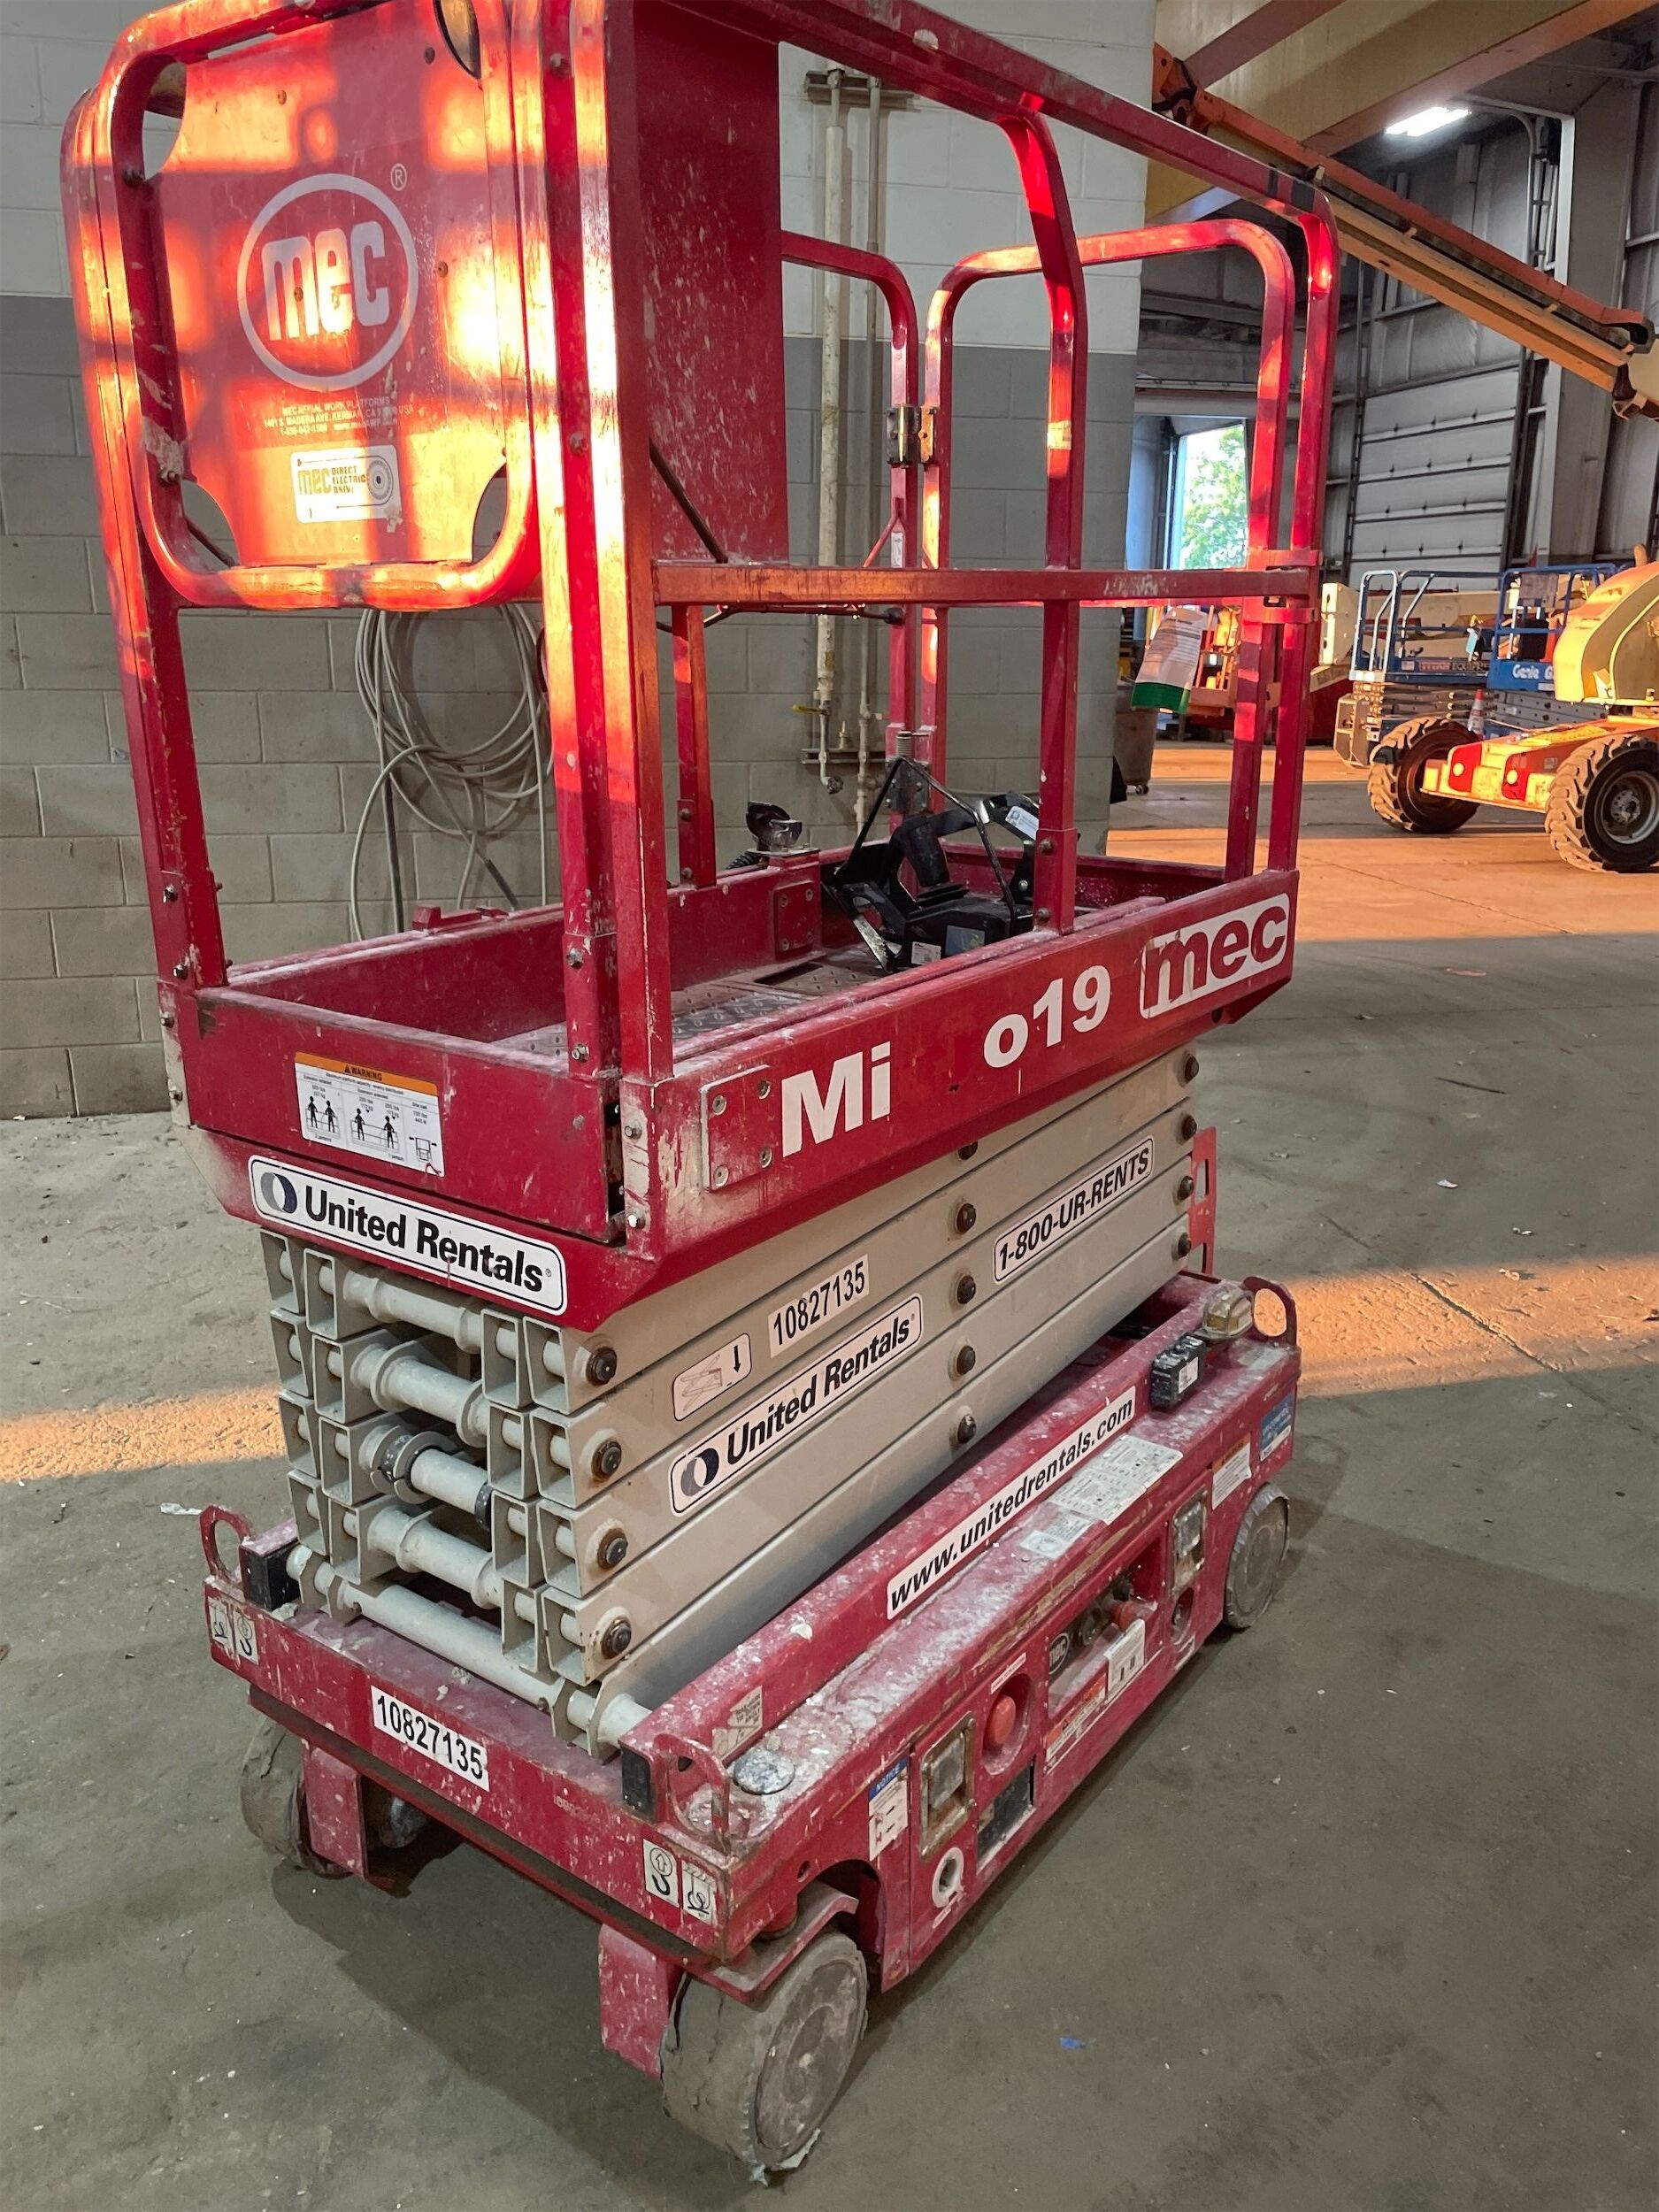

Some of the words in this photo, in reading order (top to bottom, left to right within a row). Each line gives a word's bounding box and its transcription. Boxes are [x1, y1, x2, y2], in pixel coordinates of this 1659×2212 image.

[332, 465, 357, 476] DIRECT
[333, 473, 367, 485] ELECTRIC
[1512, 664, 1540, 680] Genie
[351, 1066, 383, 1082] WARNING
[781, 1041, 891, 1157] Mi
[305, 1185, 407, 1248] United
[416, 1218, 543, 1293] Rentals
[999, 1146, 1151, 1271] 1-800-UR-RENTS
[773, 1260, 865, 1346] 10827135
[727, 1373, 818, 1465] United
[824, 1317, 910, 1398] Rentals
[891, 1399, 1133, 1611] www.unitedrentals.com
[377, 1695, 483, 1779] 10827135
[876, 1763, 901, 1793] NOTICE
